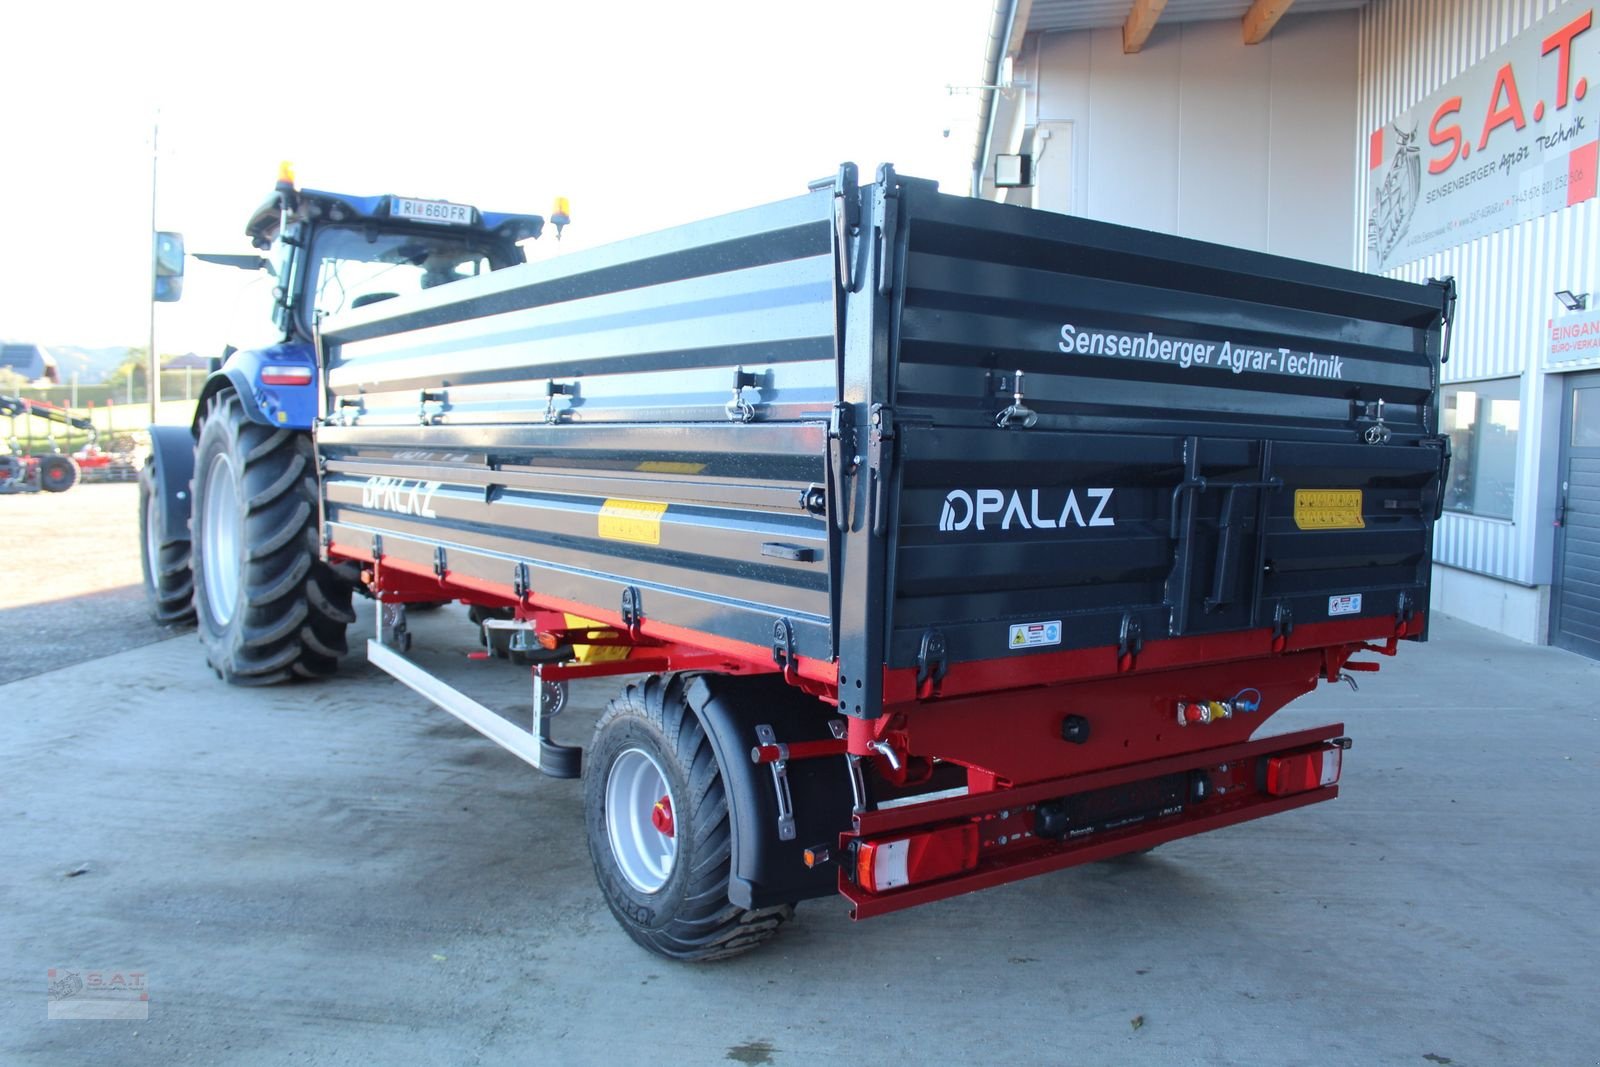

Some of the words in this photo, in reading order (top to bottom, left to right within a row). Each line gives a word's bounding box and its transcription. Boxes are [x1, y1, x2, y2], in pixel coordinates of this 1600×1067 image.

[1428, 8, 1593, 175] S.A.T.
[1426, 161, 1496, 204] SENSENBERGER
[1536, 116, 1585, 152] Technik
[1059, 324, 1215, 368] Sensenberger
[1217, 341, 1343, 378] Agrar-Technik
[1551, 338, 1600, 353] BÜRO-VERKA
[939, 488, 1115, 531] OPALAZ
